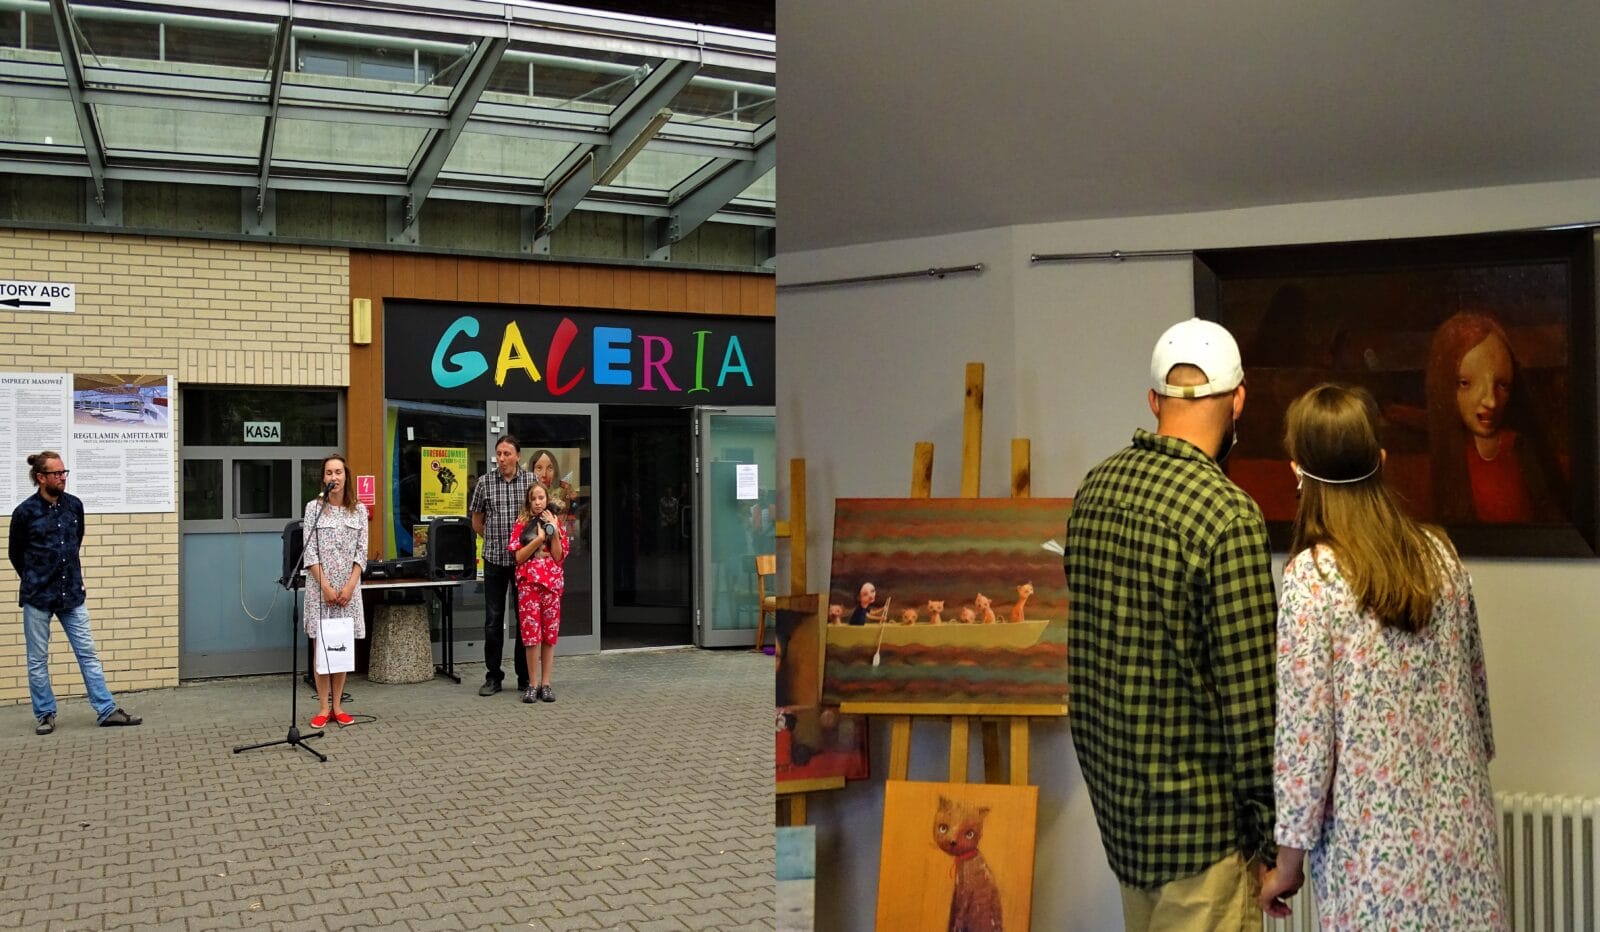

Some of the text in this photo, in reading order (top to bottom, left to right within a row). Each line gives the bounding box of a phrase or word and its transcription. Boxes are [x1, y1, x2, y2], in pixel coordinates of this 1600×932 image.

[0, 284, 71, 298] TORY ABC
[431, 315, 754, 396] GALERIA
[246, 425, 279, 438] KASA
